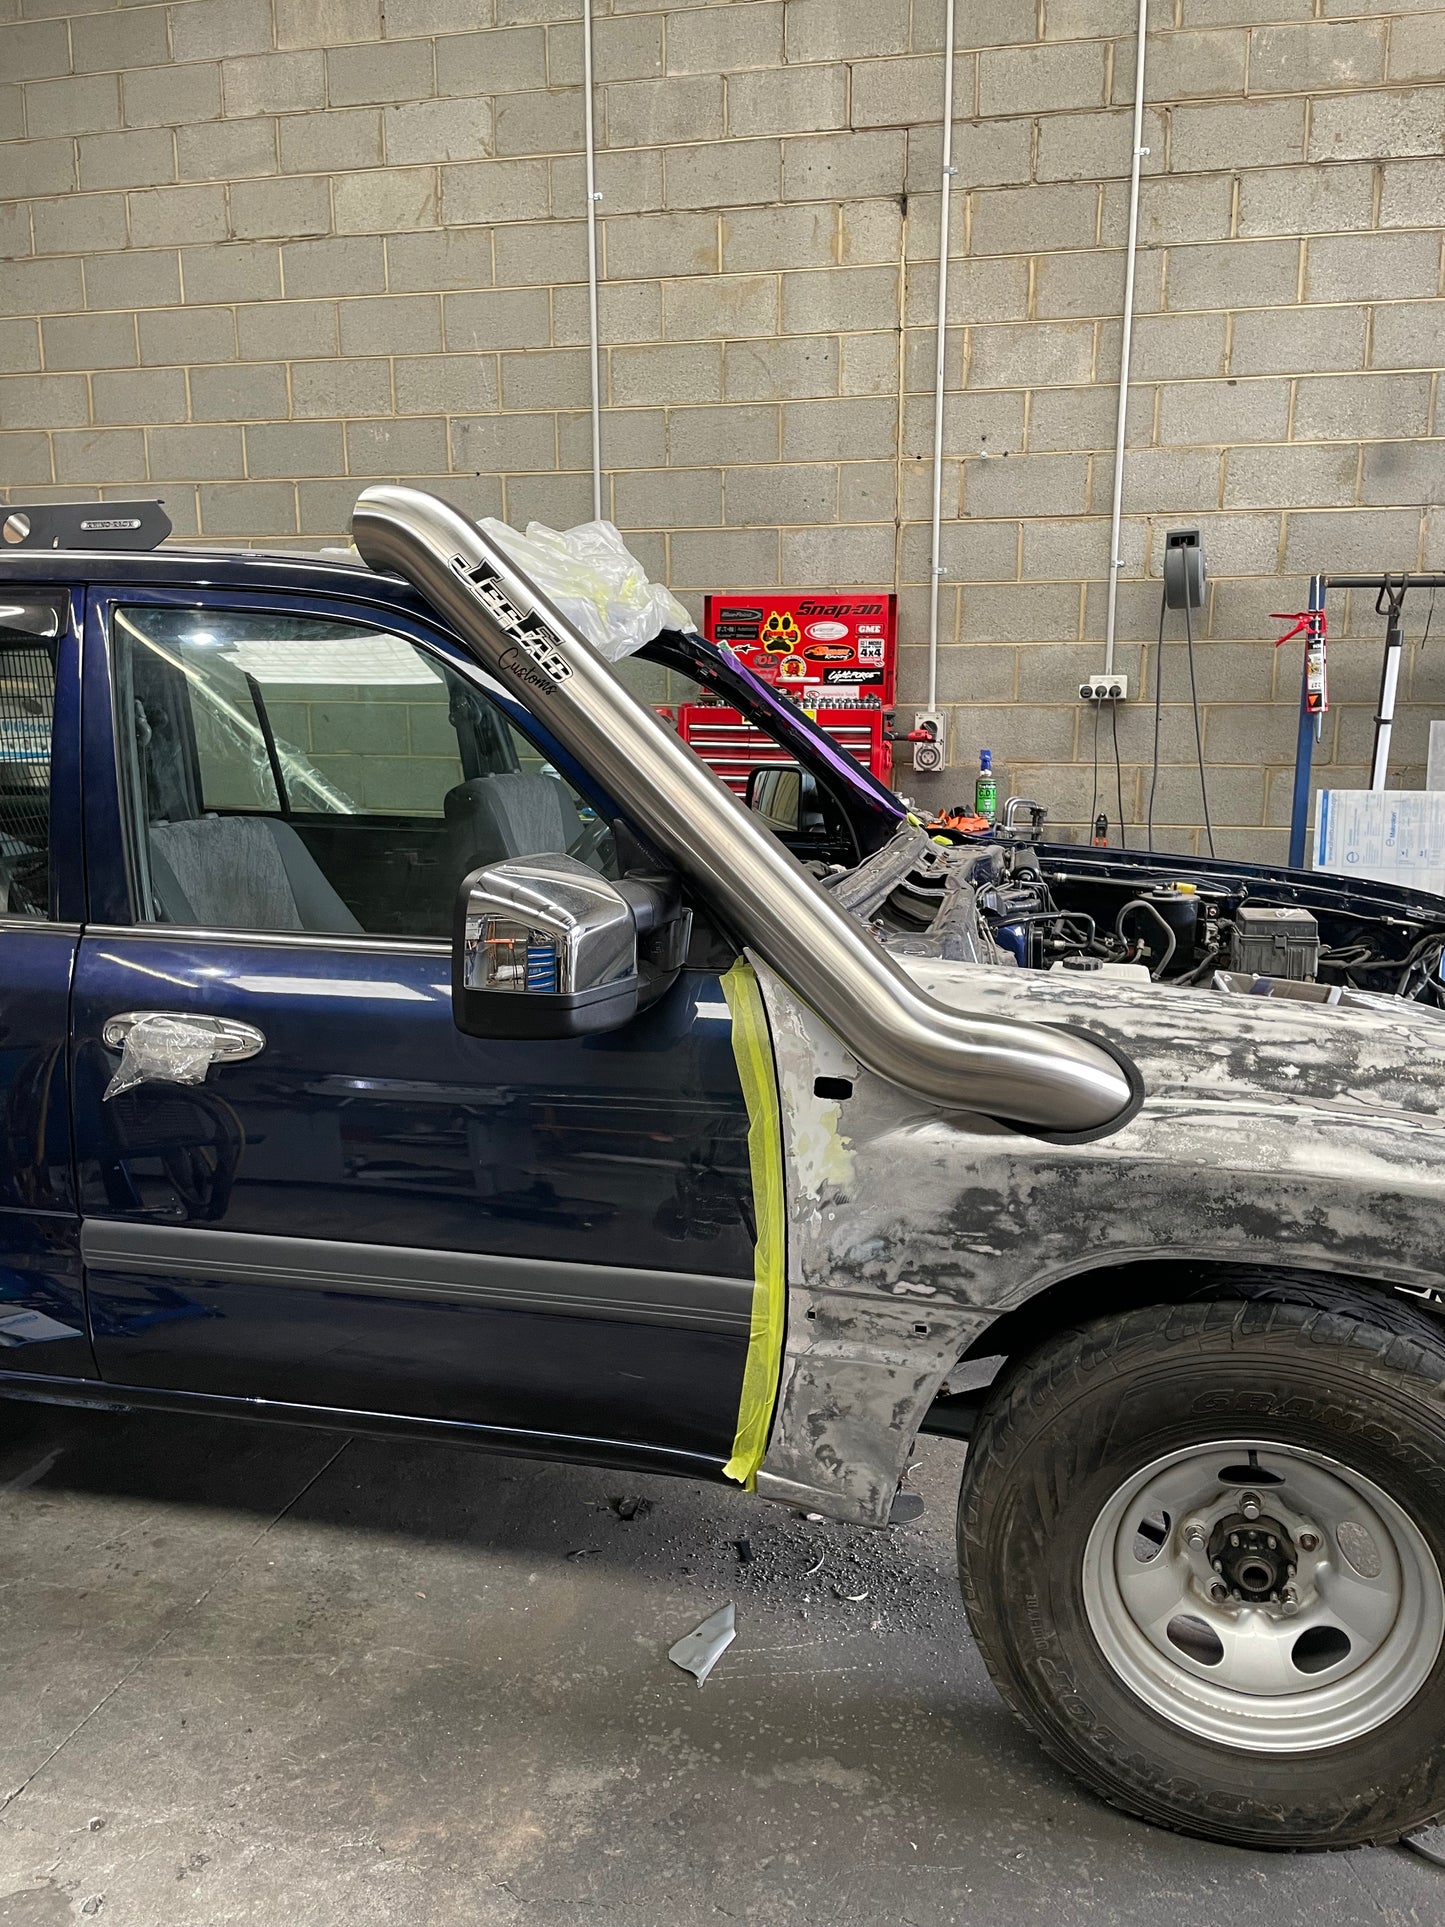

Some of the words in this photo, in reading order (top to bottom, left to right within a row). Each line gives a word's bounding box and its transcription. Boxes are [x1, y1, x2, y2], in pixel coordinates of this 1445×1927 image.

[795, 601, 883, 618] Snap-on
[858, 625, 881, 634] GME
[860, 649, 882, 657] 4x4
[497, 647, 558, 696] Customs
